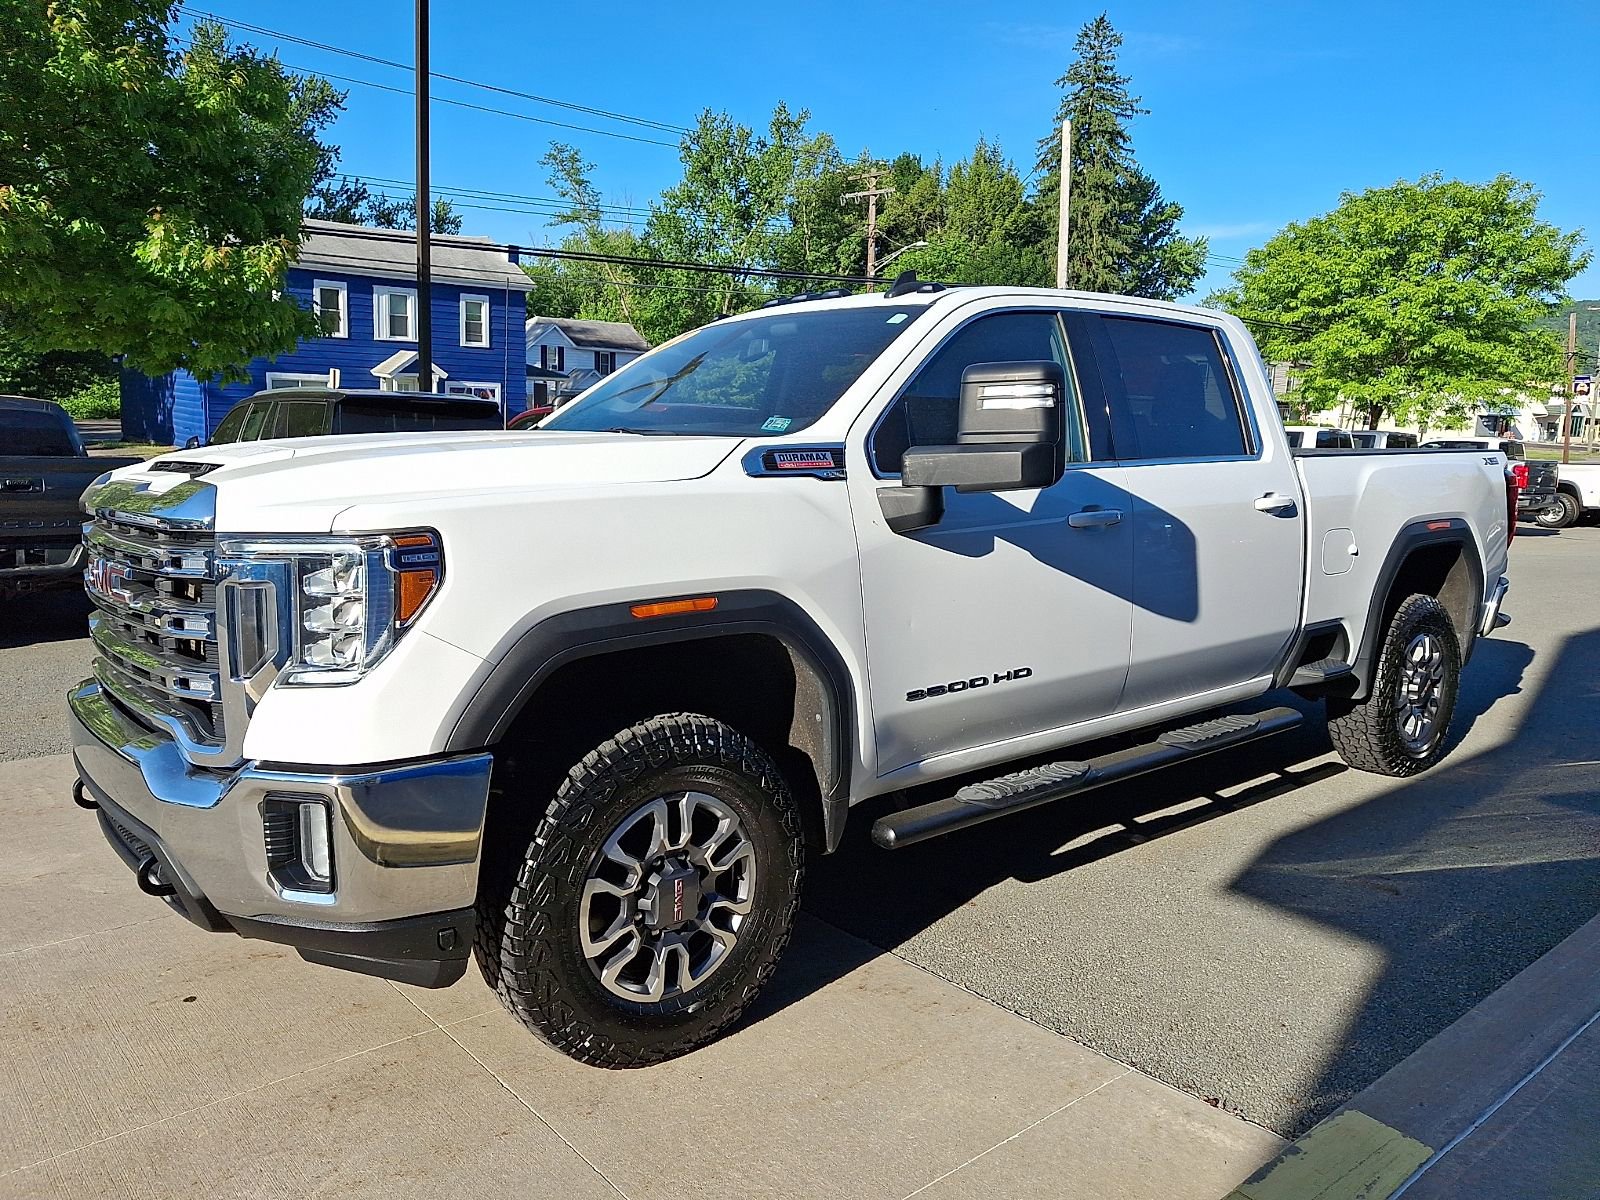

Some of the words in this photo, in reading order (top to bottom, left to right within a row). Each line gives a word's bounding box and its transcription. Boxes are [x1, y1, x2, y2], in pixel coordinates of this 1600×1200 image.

[778, 453, 829, 462] DURAMAX
[88, 558, 133, 604] GMC
[993, 667, 1033, 683] HD
[674, 879, 683, 921] GMC
